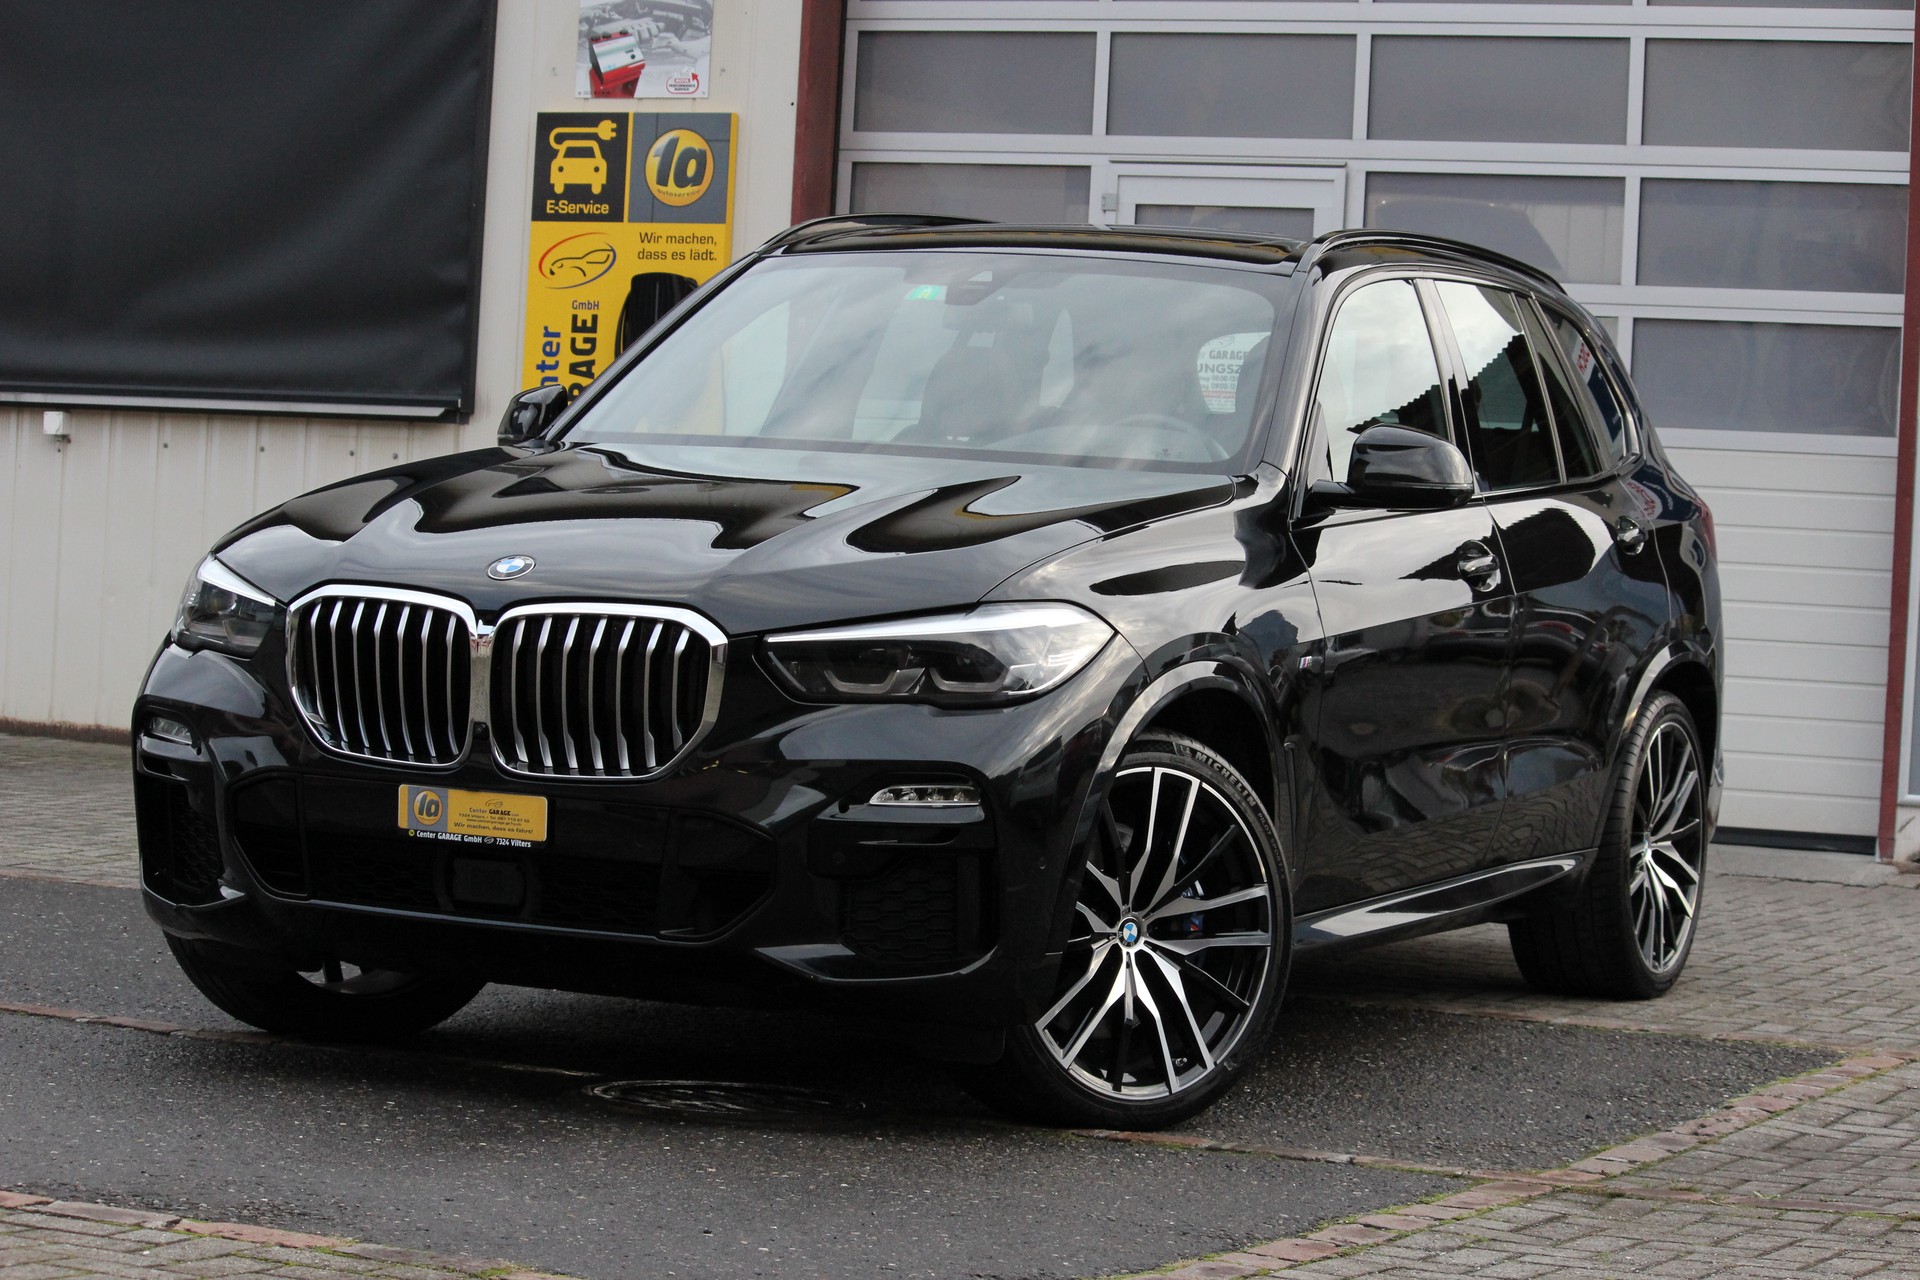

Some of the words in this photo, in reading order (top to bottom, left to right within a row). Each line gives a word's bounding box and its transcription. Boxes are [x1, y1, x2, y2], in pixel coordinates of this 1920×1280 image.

[546, 199, 610, 214] E-Service
[639, 232, 663, 244] Wir
[665, 232, 717, 246] machen,
[637, 249, 668, 261] dass
[671, 251, 686, 261] es
[689, 249, 717, 261] lädt.
[571, 299, 600, 310] GmbH
[1195, 751, 1257, 807] MICHELIN
[488, 808, 512, 816] GARAGE
[416, 830, 436, 839] Center
[437, 832, 462, 842] GARAGE
[463, 835, 482, 843] GmbH
[496, 837, 510, 846] 7324
[511, 838, 532, 848] Vilters
